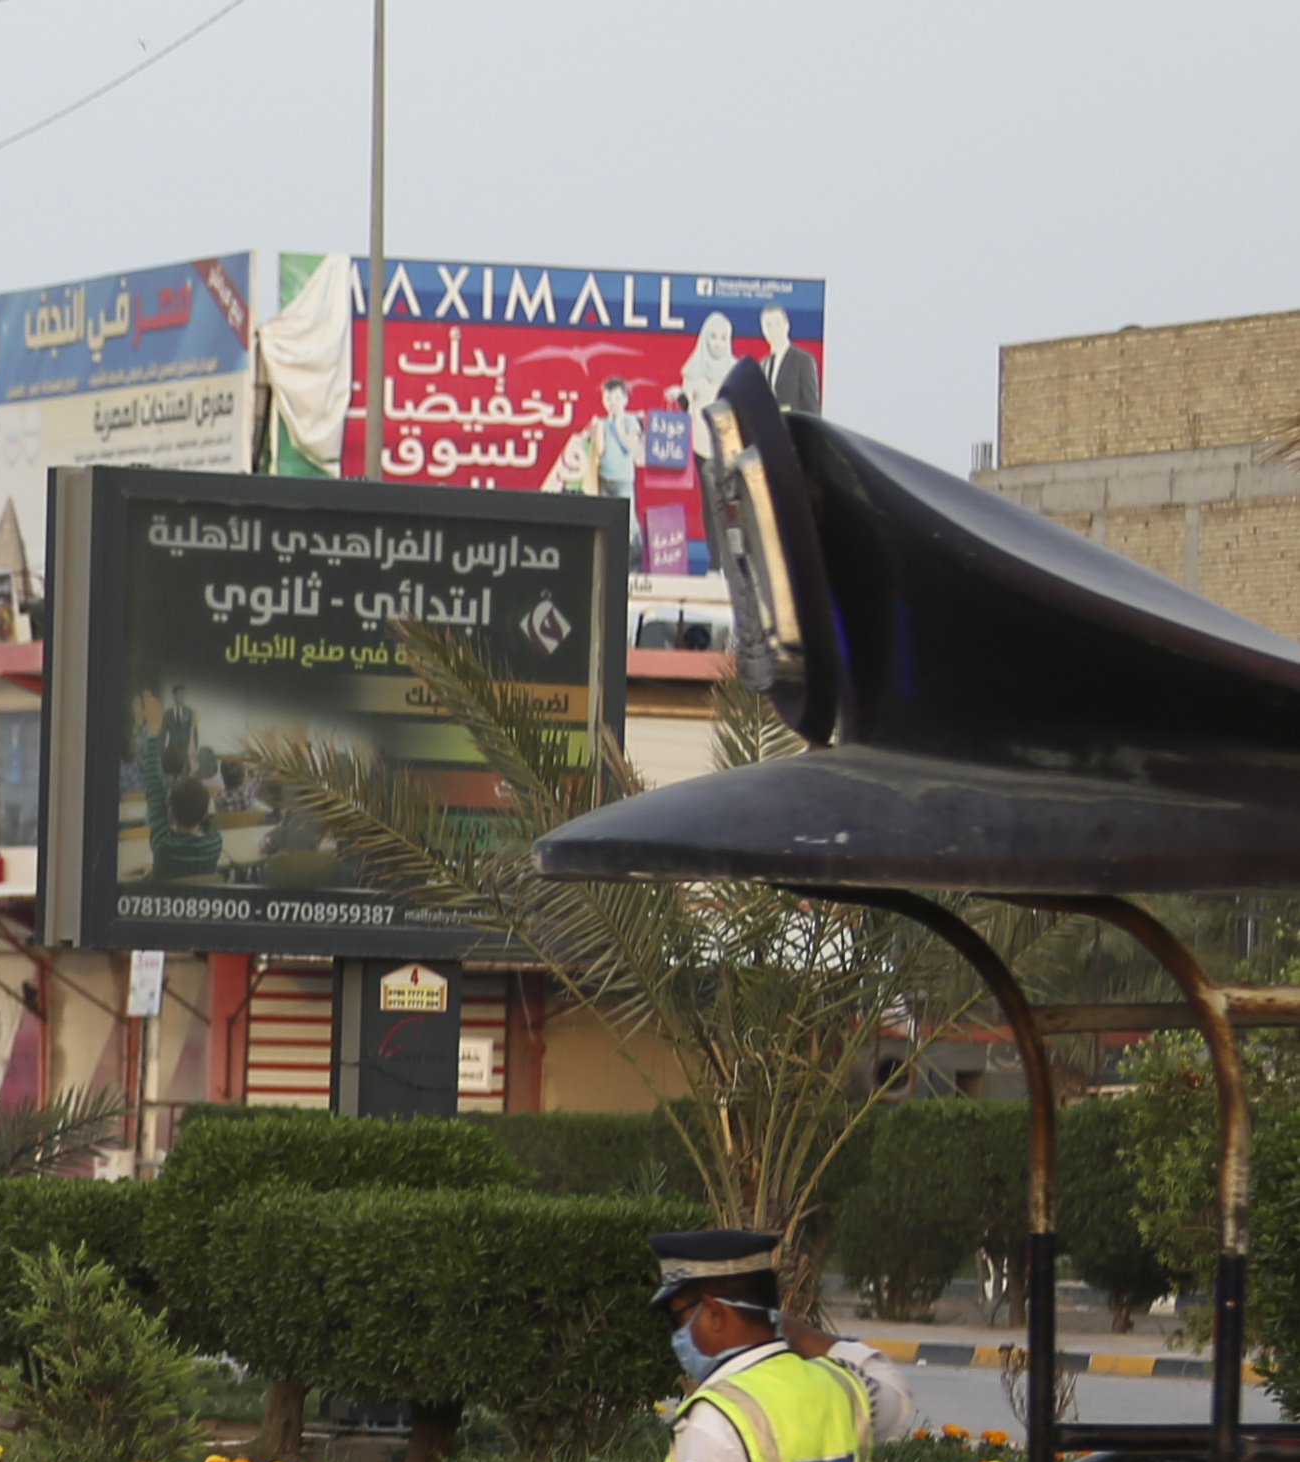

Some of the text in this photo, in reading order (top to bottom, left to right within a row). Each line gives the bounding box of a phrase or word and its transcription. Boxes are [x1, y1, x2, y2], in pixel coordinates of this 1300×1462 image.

[23, 276, 192, 363] مصر في النجف
[398, 326, 506, 383] بدأت
[93, 386, 234, 441] معرض المنتجات المصرية
[652, 416, 685, 439] جودة
[380, 425, 544, 477] تسوق
[652, 440, 684, 460] عالية
[148, 514, 560, 577] مدارس الفراهيدي الأهلية
[205, 572, 322, 625] ثانوي
[354, 580, 491, 635] ابتدائي
[226, 635, 296, 666] الأجيال
[301, 641, 345, 667] صنع
[351, 641, 388, 670] في
[117, 895, 251, 921] 07813089900
[267, 902, 395, 925] 07708959387
